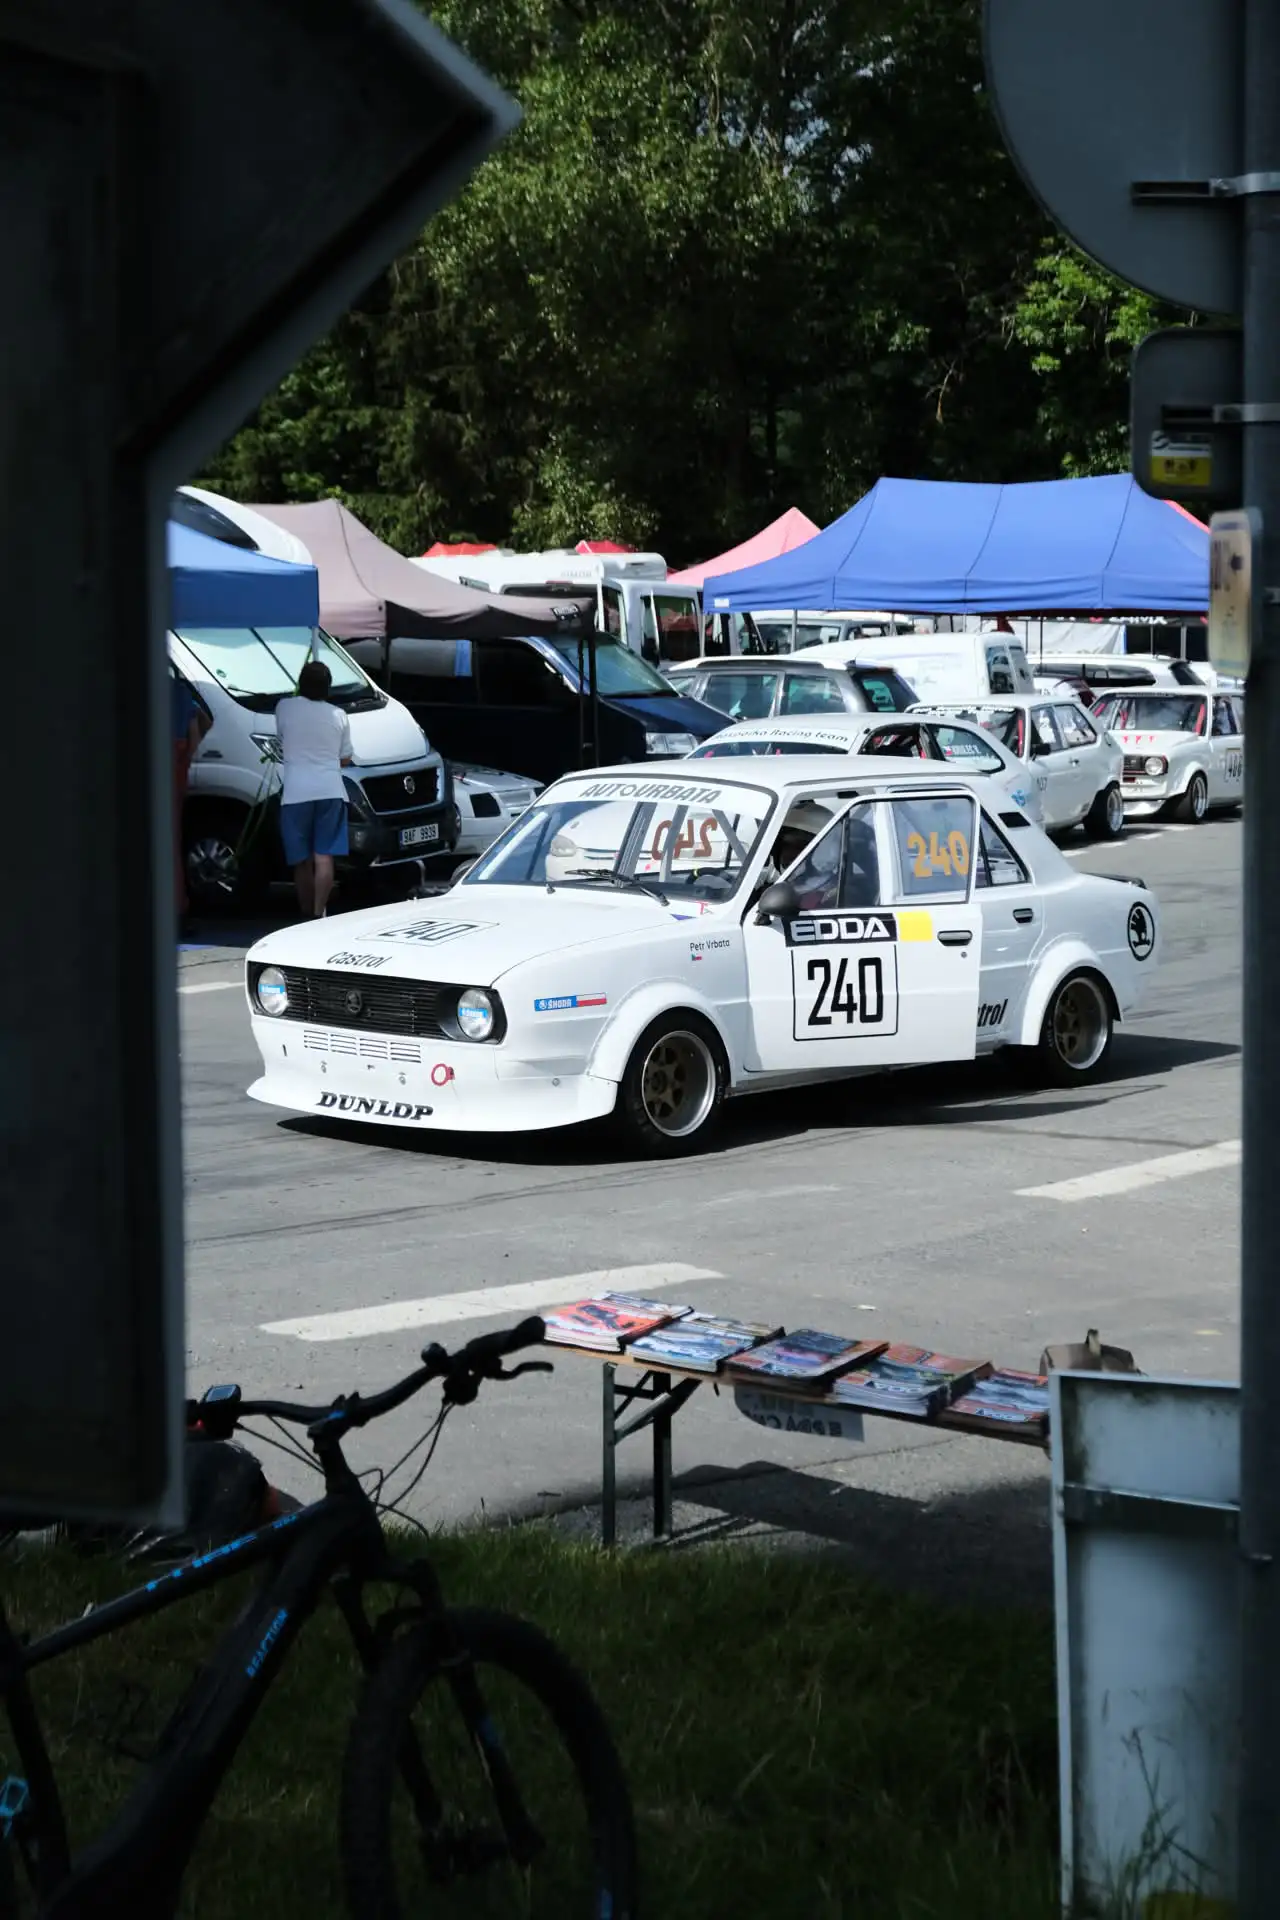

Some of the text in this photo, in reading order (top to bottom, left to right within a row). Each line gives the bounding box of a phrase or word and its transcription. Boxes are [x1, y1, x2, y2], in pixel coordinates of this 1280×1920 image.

[815, 731, 849, 743] team
[907, 830, 969, 878] 240
[378, 920, 479, 941] 240
[790, 917, 890, 942] EDDA
[689, 939, 730, 951] Petr Vrbata
[327, 951, 392, 968] Castrol
[807, 957, 884, 1026] 240
[977, 999, 1009, 1028] trol
[316, 1091, 433, 1121] DUNLOP
